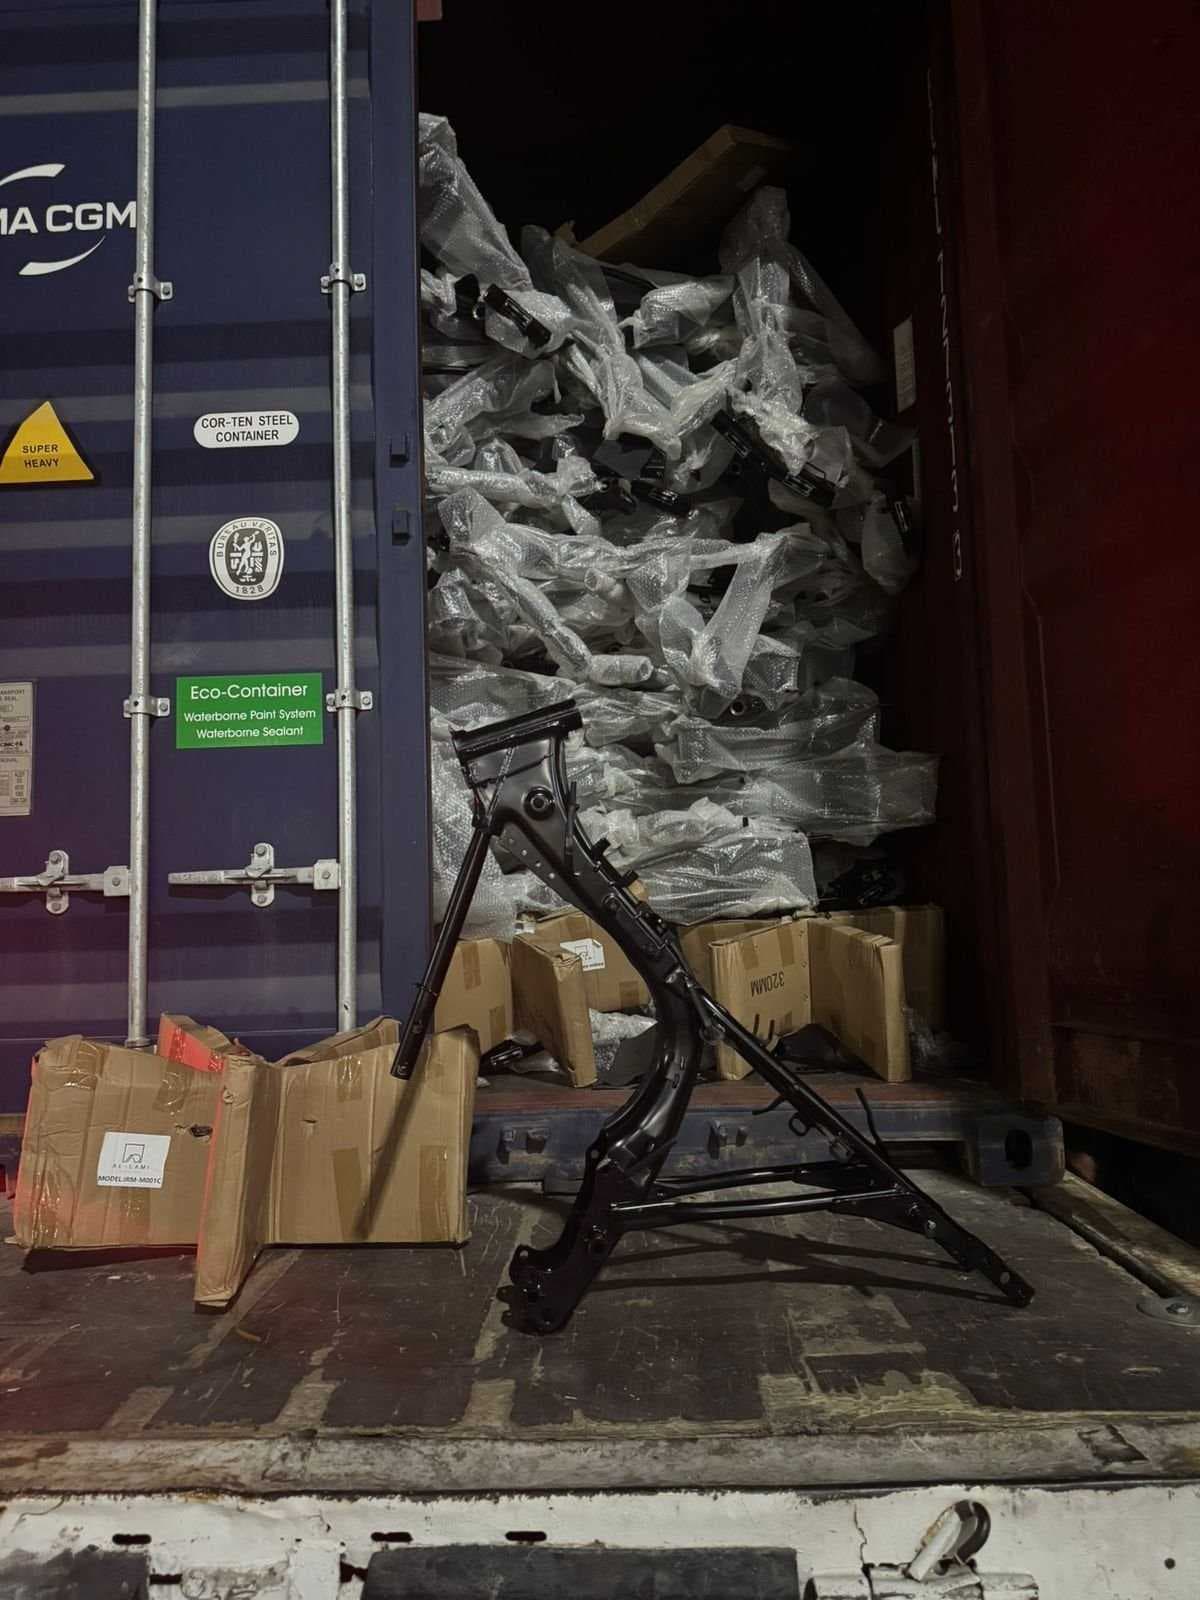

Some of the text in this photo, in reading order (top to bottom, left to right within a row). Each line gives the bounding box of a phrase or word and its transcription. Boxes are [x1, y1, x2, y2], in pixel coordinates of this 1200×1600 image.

[0, 201, 136, 235] A CGM
[201, 415, 293, 429] COR-TEN STEEL
[216, 429, 279, 442] CONTAINER
[22, 444, 58, 454] SUPER
[24, 459, 59, 468] HEAVY
[253, 521, 277, 556] VERITAS
[236, 584, 264, 594] 1828
[190, 683, 308, 700] Eco-Container
[184, 709, 316, 722] Waterborne Paint System
[196, 726, 303, 739] Waterborne Sealant
[751, 971, 784, 997] 320MM
